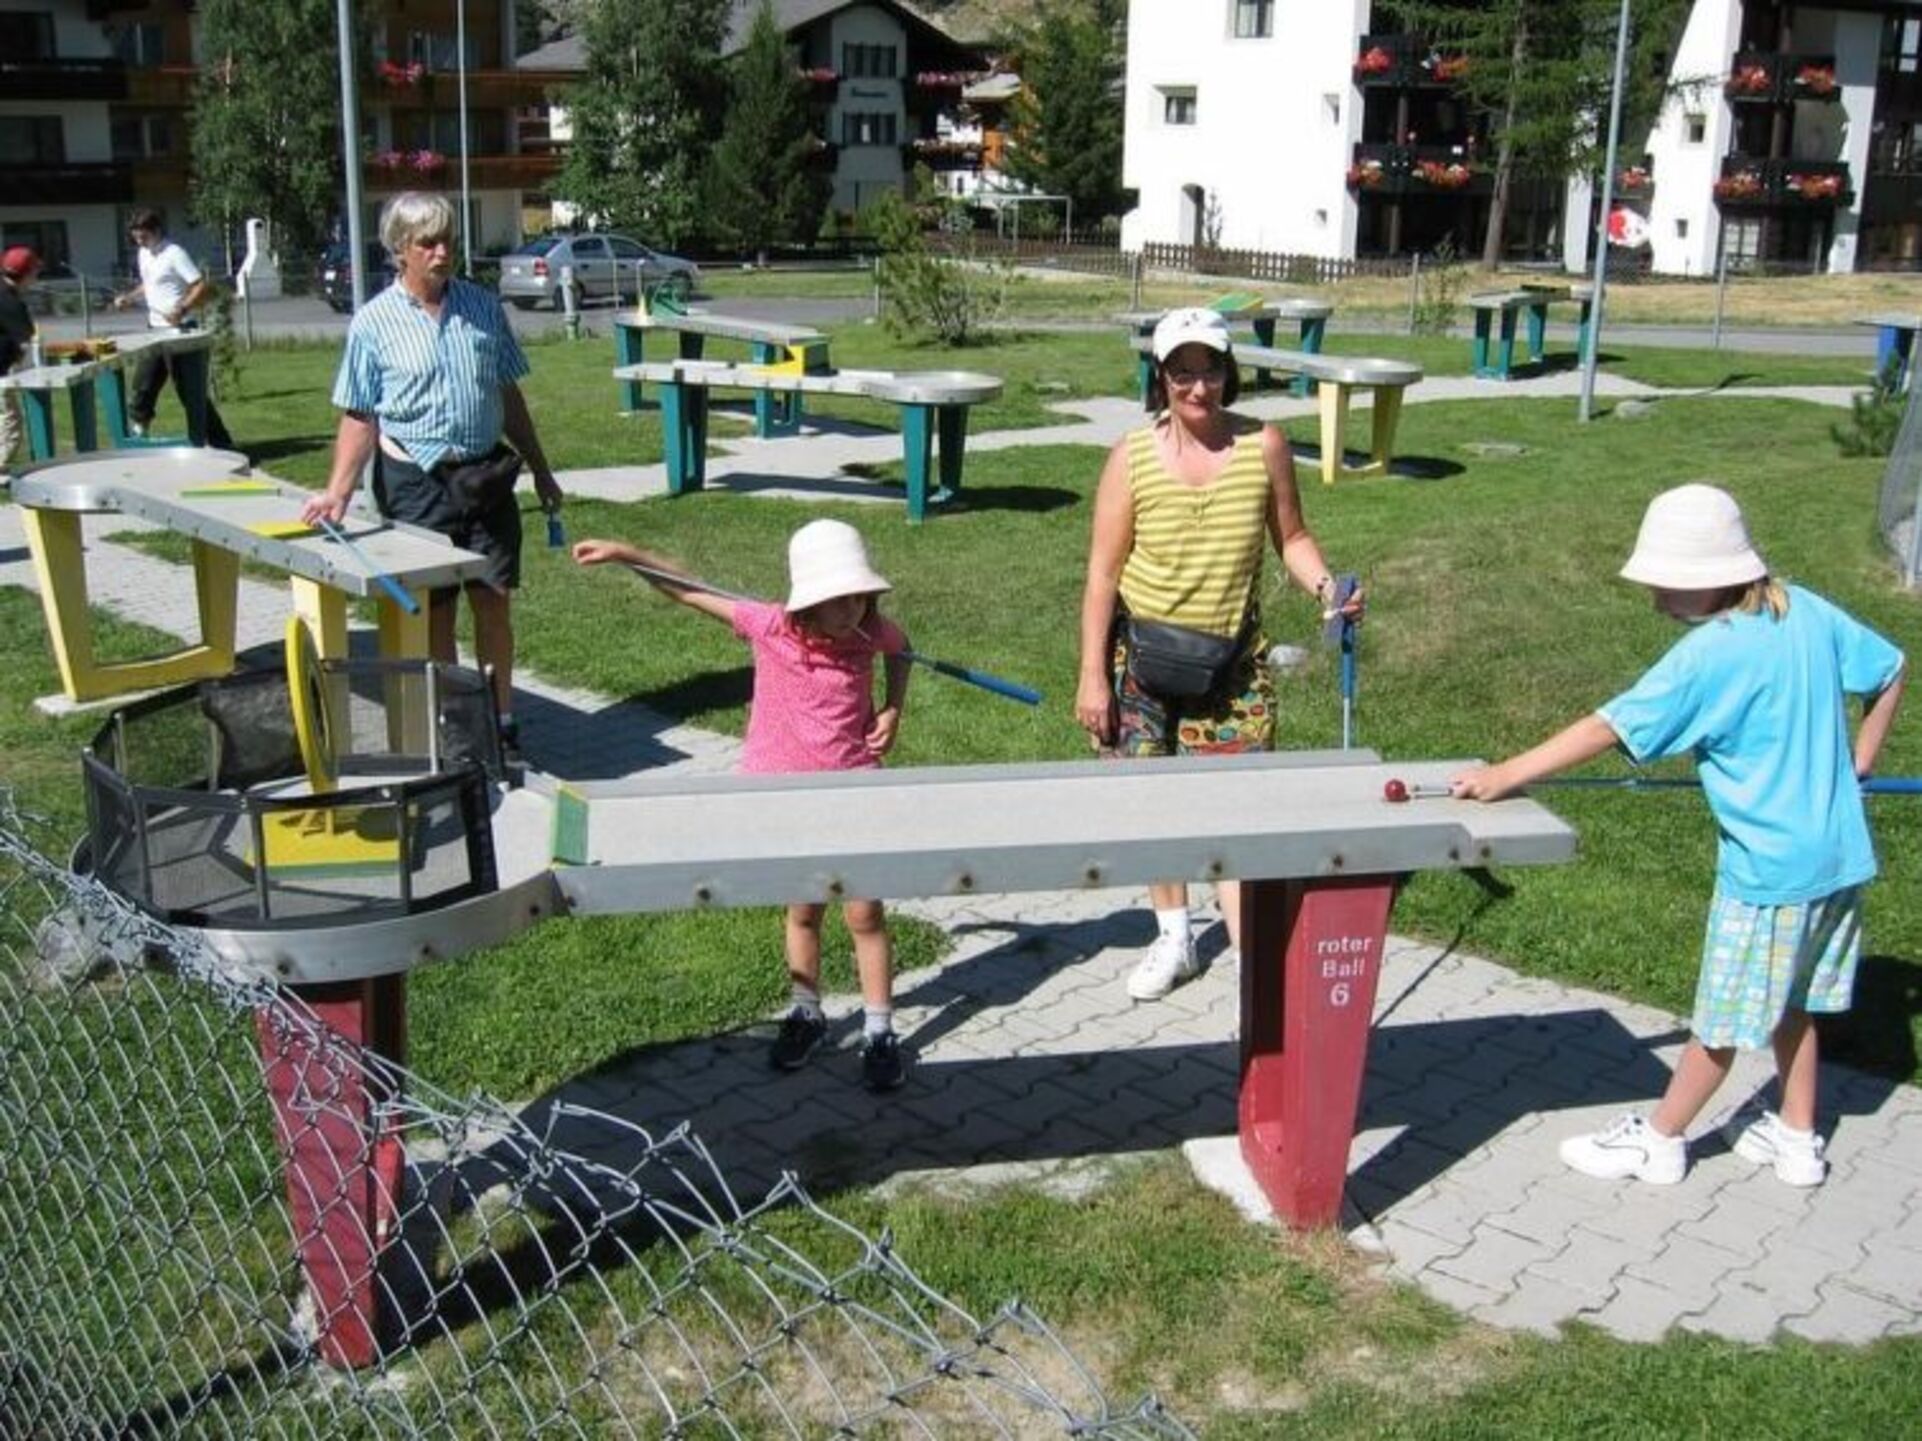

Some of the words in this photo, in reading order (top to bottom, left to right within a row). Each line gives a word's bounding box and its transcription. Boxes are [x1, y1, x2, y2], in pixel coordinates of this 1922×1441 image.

[1317, 936, 1373, 955] roter
[1322, 957, 1365, 978] Ball
[1330, 982, 1350, 1008] 6
